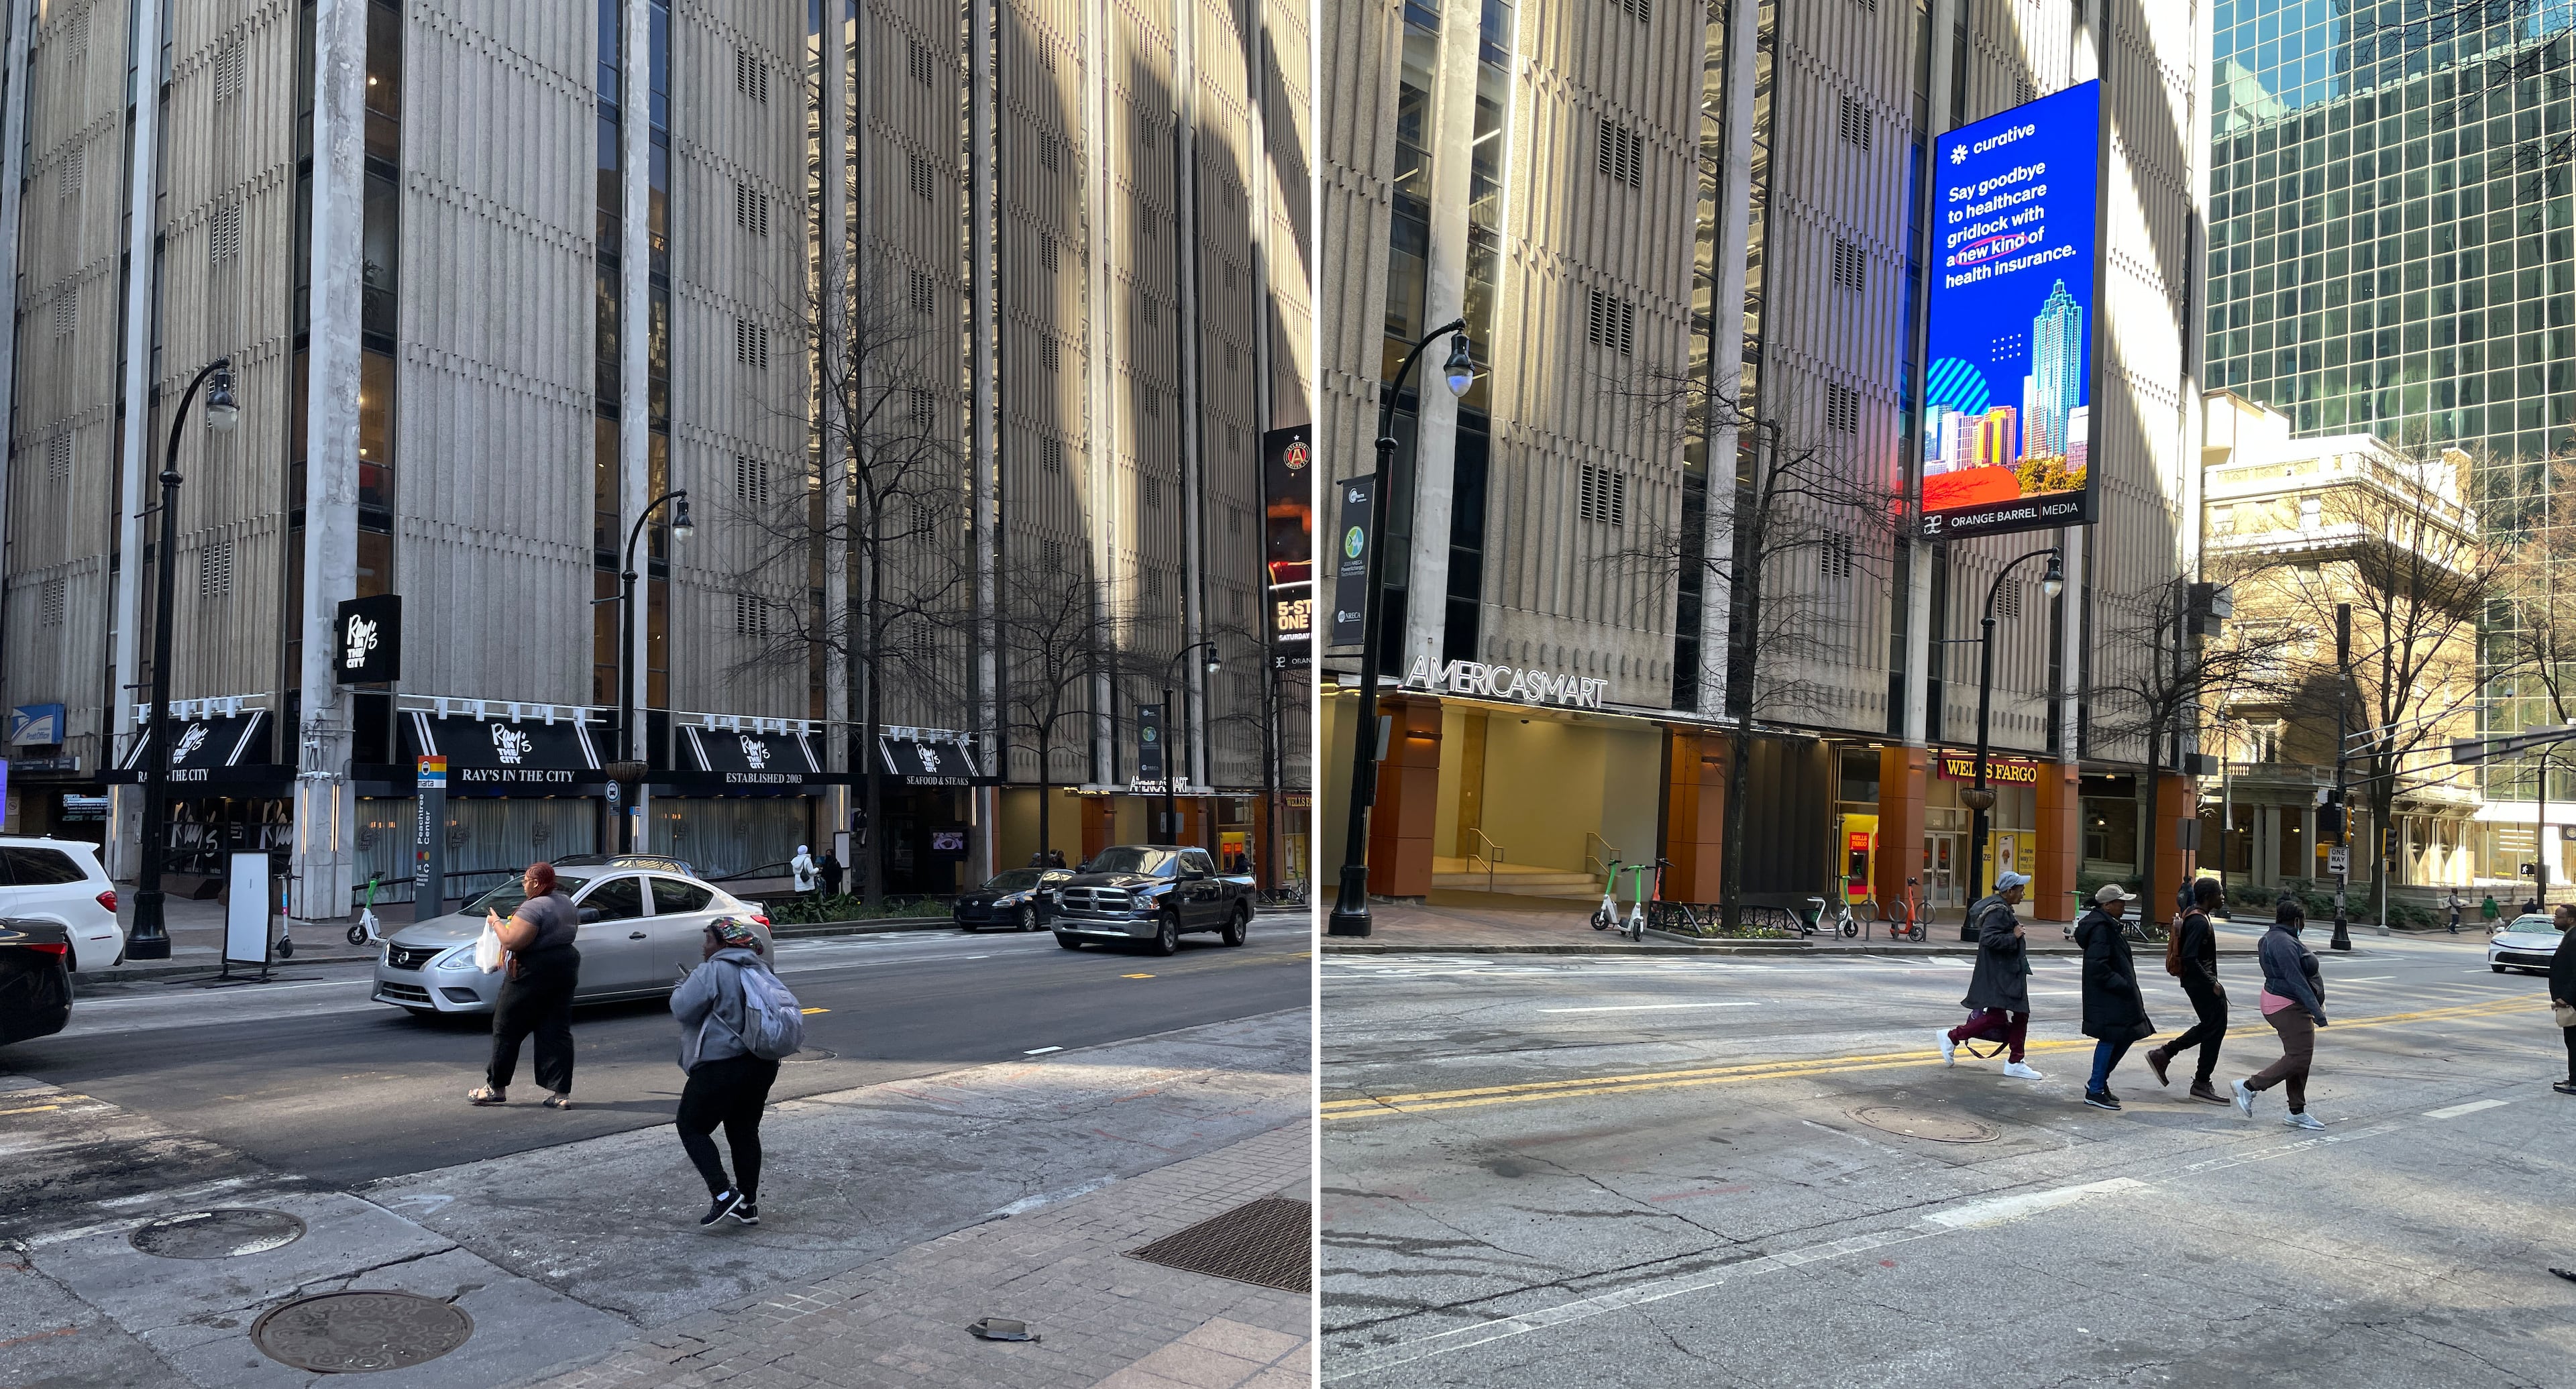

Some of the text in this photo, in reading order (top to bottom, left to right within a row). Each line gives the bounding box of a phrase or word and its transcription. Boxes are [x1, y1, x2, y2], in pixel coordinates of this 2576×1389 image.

[1973, 123, 2035, 154] curative
[1949, 162, 2045, 203] Say goodbye
[1948, 184, 2047, 224] to healthcare
[1947, 205, 2045, 248] gridlock with
[1946, 225, 2045, 267] a new kind of
[1945, 244, 2077, 289] health insurance.
[1951, 502, 2078, 527] ORANGE BARREL MEDIA
[1279, 614, 1309, 630] ONE
[347, 614, 378, 657] Ray's
[354, 637, 364, 648] IN
[1279, 632, 1310, 641] SATURDAY
[346, 657, 365, 668] CITY
[347, 648, 364, 658] THE
[1405, 655, 1608, 708] AMERICASMART
[26, 731, 50, 740] Post Office
[178, 722, 209, 752] Ray's
[491, 723, 532, 756] Ray's
[497, 748, 517, 756] THE
[500, 756, 521, 764] CITY
[739, 735, 771, 763] Ray's
[916, 743, 941, 767] Ray's
[172, 769, 209, 781] THE CITY
[462, 769, 575, 782] RAY'S IN THE CITY
[726, 773, 802, 783] ESTABLISHED 2003
[906, 776, 969, 785] SEAFOOD & STEAKS
[1946, 759, 2037, 783] WELS FARGO
[1286, 797, 1306, 807] WELLS
